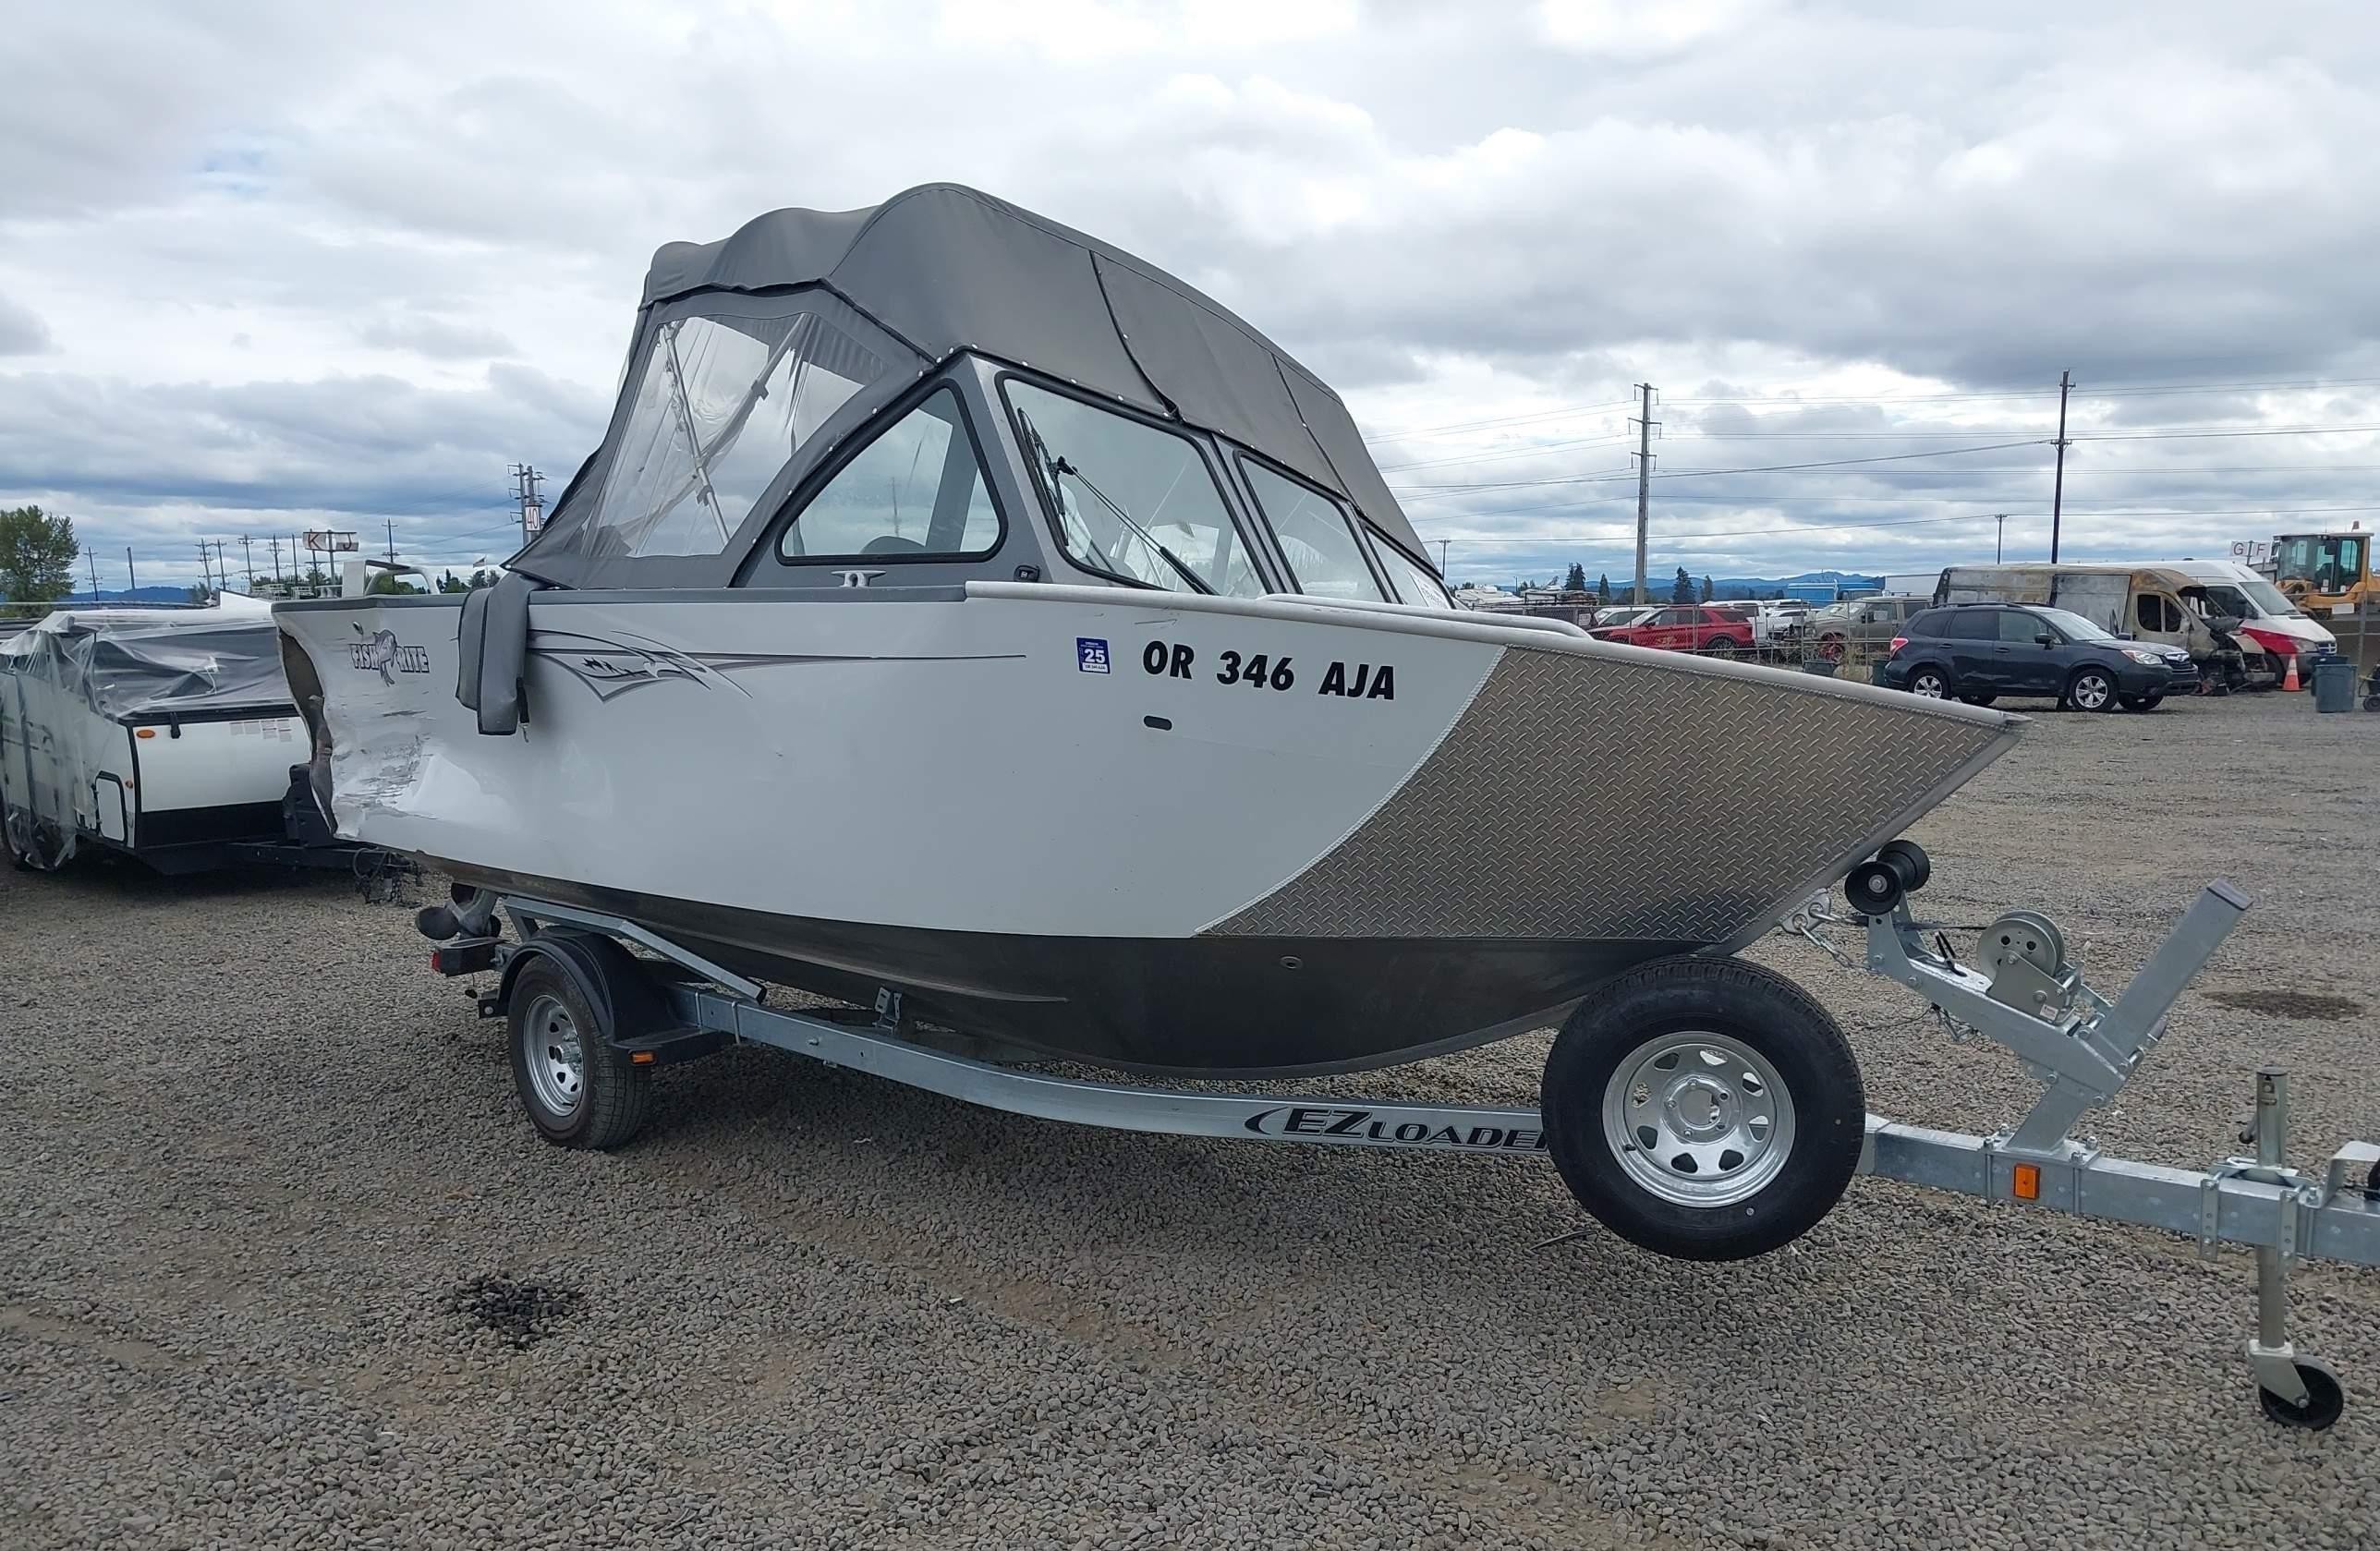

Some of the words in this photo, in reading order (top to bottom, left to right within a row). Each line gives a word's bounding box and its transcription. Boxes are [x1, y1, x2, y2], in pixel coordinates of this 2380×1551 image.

[527, 508, 539, 529] 40
[307, 533, 322, 550] K
[343, 533, 353, 550] J
[2233, 542, 2244, 555] G
[2257, 543, 2265, 555] F
[349, 644, 380, 670] FISH
[395, 645, 430, 673] RITE
[1084, 648, 1106, 663] 25
[1142, 640, 1196, 680] OR
[1216, 650, 1295, 692] 346
[1318, 661, 1396, 700] AJA
